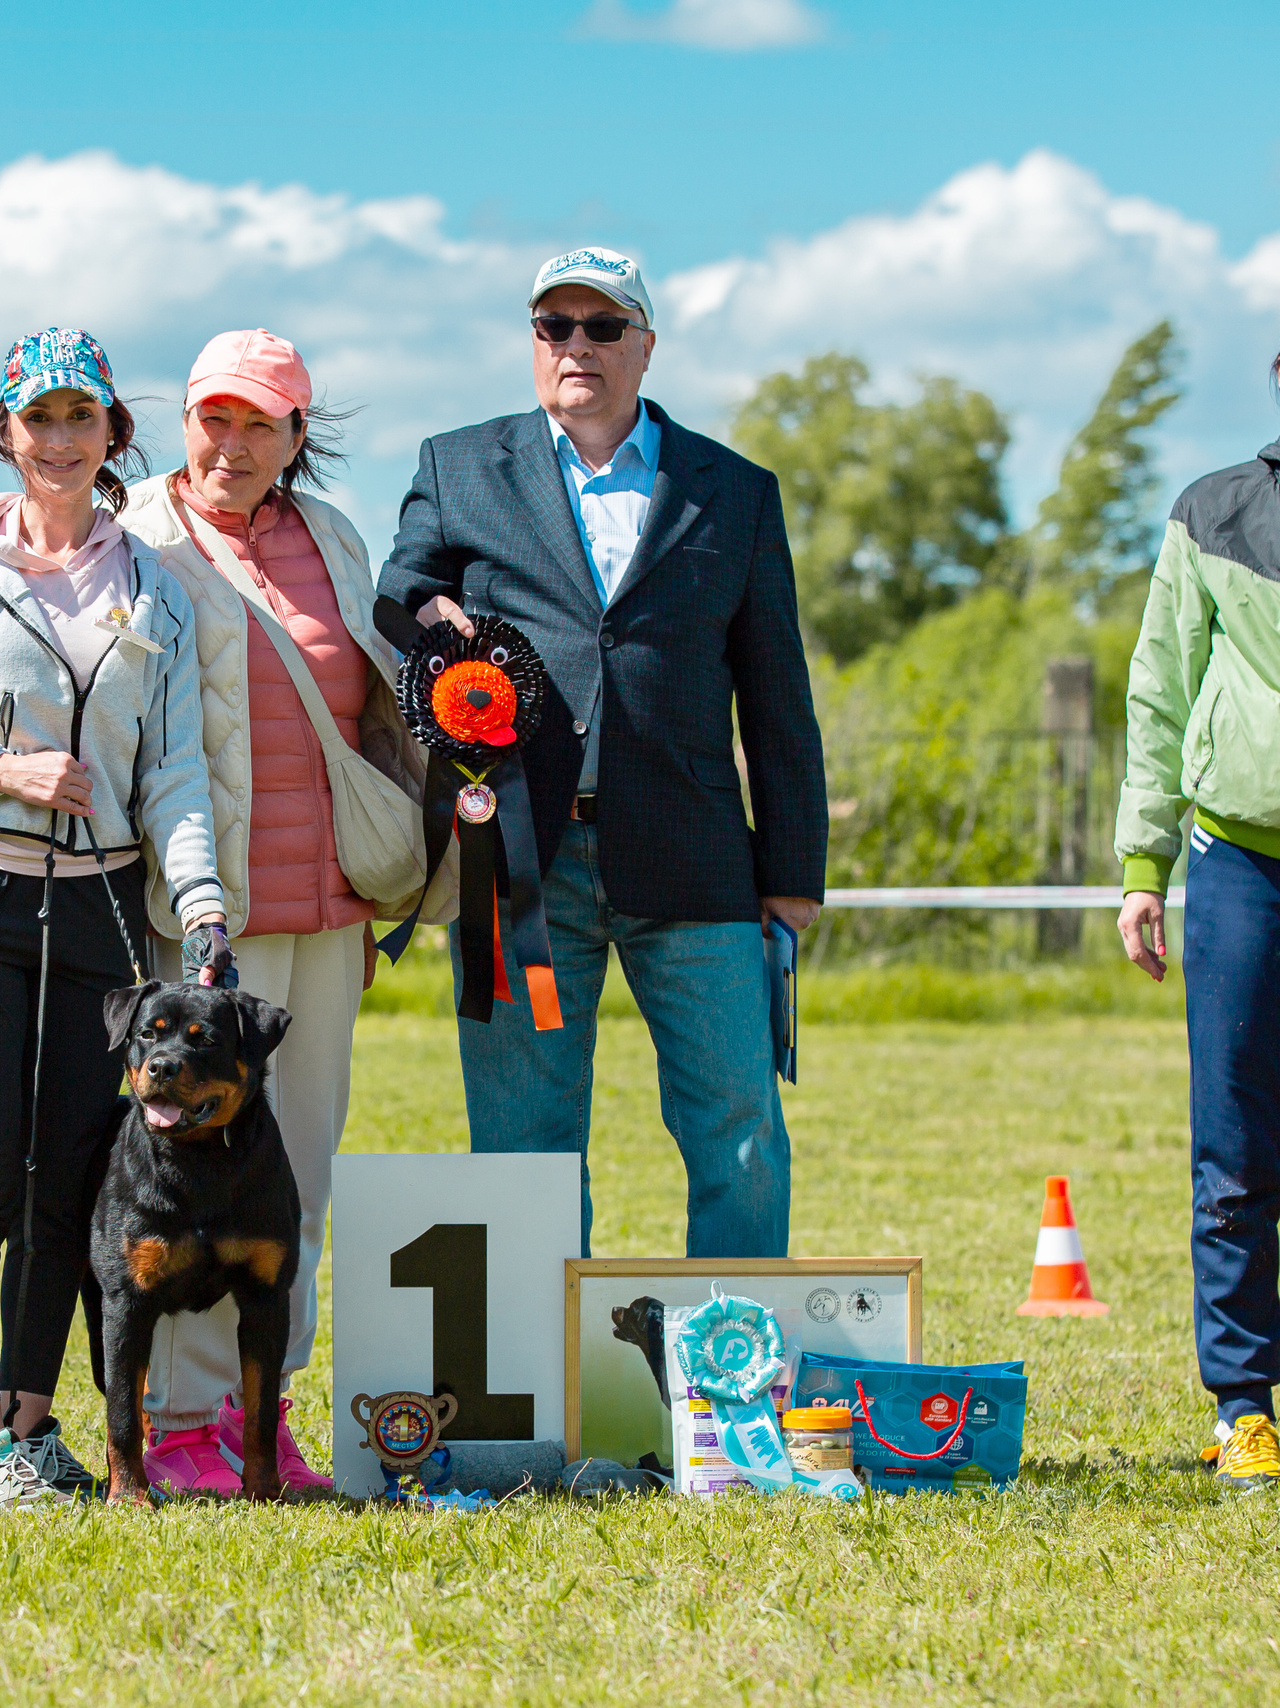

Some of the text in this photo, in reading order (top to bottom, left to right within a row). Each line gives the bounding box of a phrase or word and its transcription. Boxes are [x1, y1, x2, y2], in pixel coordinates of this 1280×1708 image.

[390, 1224, 534, 1441] 1
[394, 1413, 409, 1441] 1
[869, 1433, 906, 1442] PODUCE
[746, 1425, 783, 1470] PUPPY
